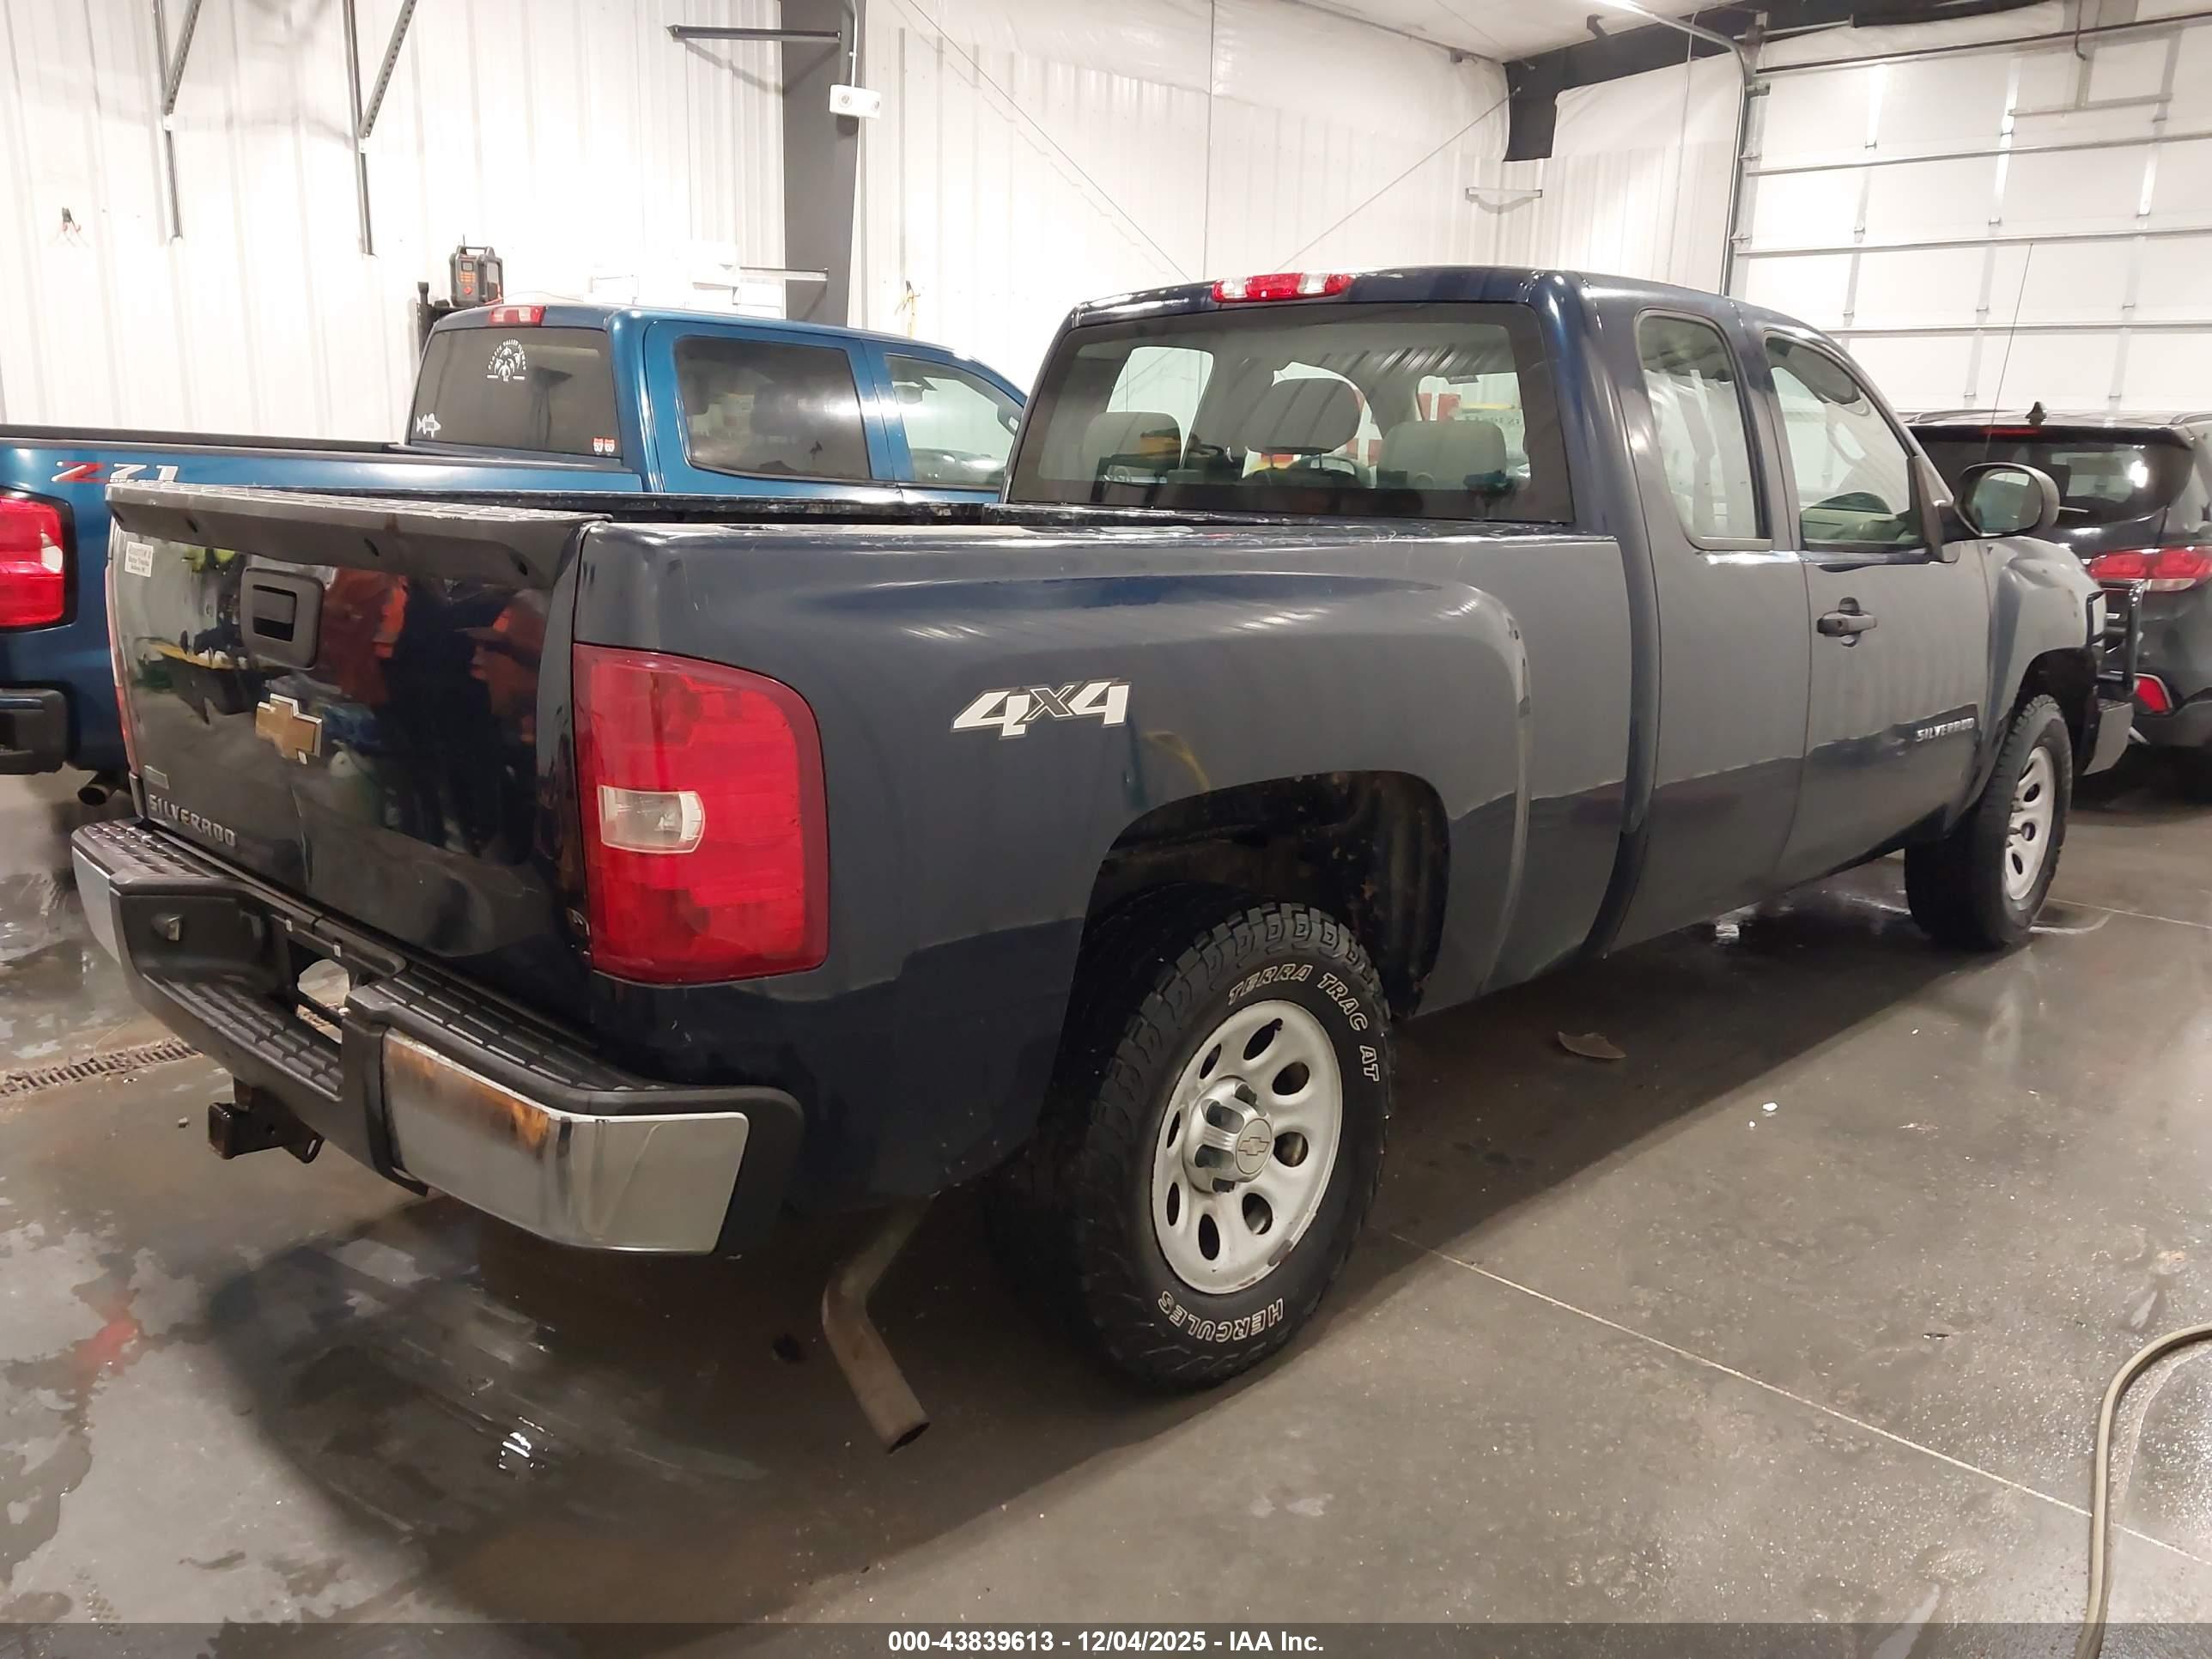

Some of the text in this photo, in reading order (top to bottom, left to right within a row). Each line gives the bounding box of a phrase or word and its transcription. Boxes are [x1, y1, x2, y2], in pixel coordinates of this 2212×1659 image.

[51, 460, 179, 483] Z71
[149, 793, 237, 848] SILVERADO
[1228, 963, 1379, 1082] TERRA TRAC AT
[1158, 1291, 1284, 1343] HERCULES
